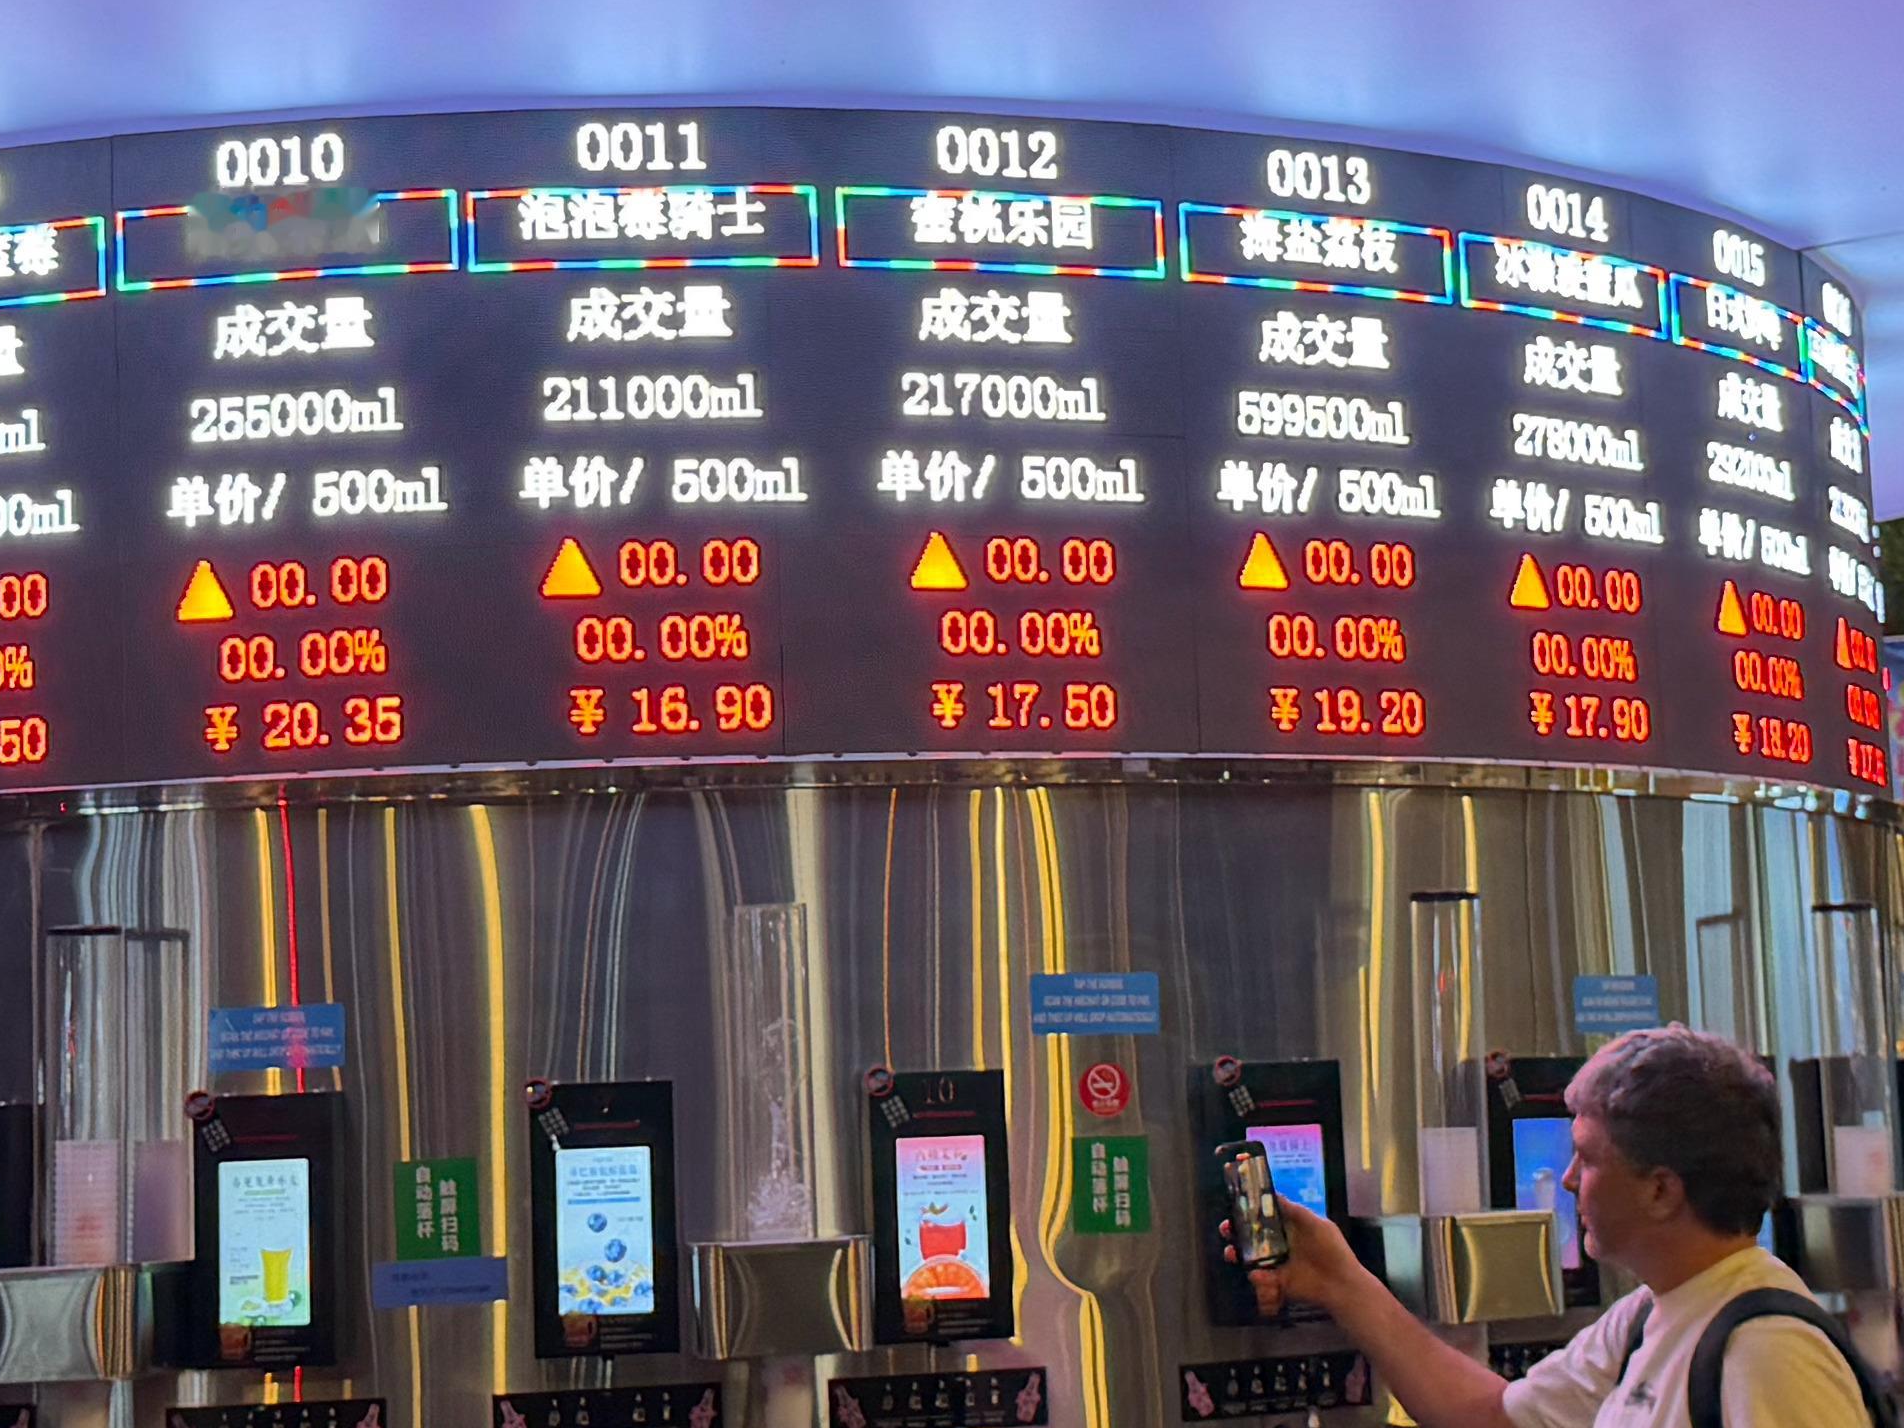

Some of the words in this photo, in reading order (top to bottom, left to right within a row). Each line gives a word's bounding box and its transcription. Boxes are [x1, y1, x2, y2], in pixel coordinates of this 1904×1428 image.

[216, 132, 344, 189] 0010
[576, 121, 707, 171] 0011
[936, 125, 1058, 180] 0012
[1266, 149, 1371, 205] 0013
[1526, 183, 1610, 243] 0014
[213, 296, 375, 360] 成交量
[566, 285, 733, 342] 成交量
[918, 287, 1073, 344] 成交量
[1258, 310, 1390, 369] 成交量
[1523, 335, 1623, 396] 成交量
[190, 386, 404, 443] 255000ml
[543, 373, 763, 421] 211000ml
[901, 372, 1106, 421] 217000ml
[166, 472, 286, 528] 单价/
[312, 466, 448, 517] 500ml
[518, 455, 644, 509] 单价/
[671, 457, 808, 503] 500ml
[876, 449, 996, 502] 单价/
[1020, 455, 1144, 502] 500ml
[1216, 459, 1318, 514] 单价/
[1338, 469, 1441, 518] 500ml
[1489, 478, 1570, 533] 单价/
[1584, 494, 1664, 544] 500ml
